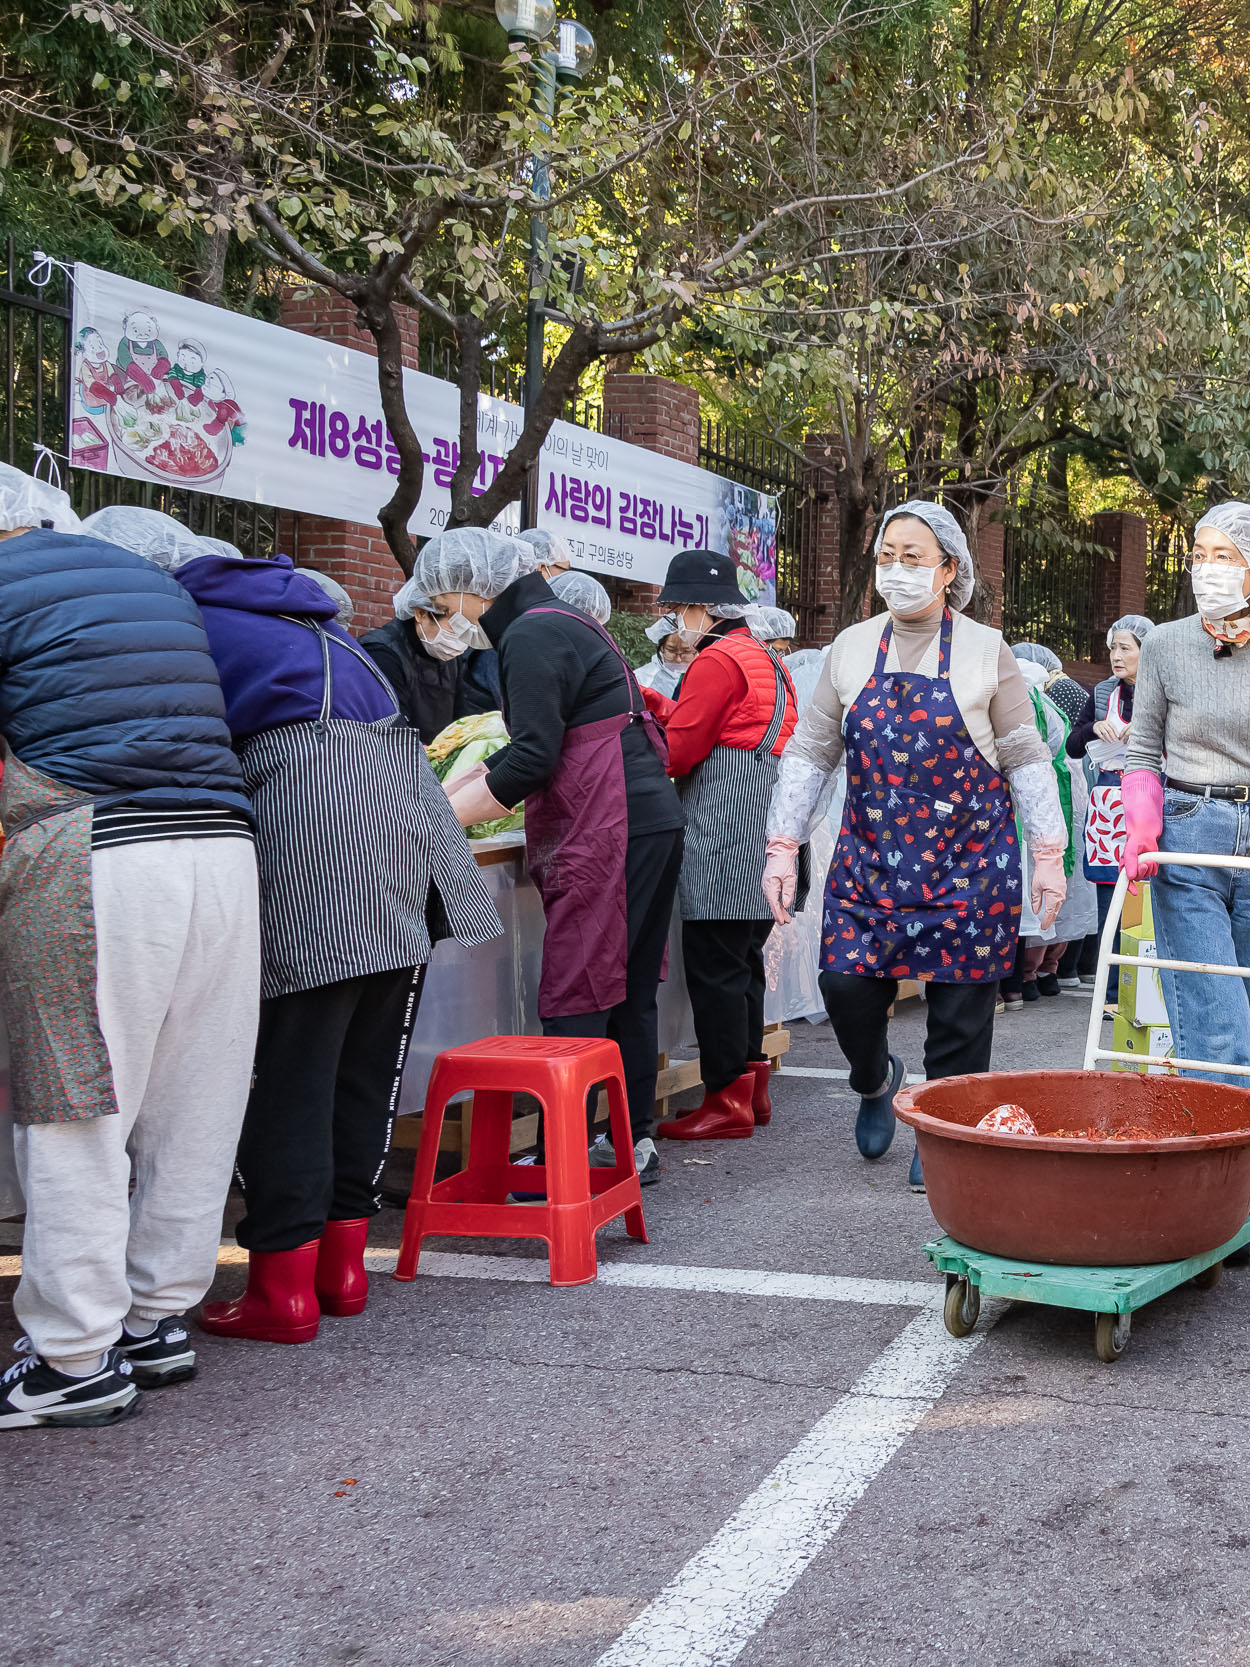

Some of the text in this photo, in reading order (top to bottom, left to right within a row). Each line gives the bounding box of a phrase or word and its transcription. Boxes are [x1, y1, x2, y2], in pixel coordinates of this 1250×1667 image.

[572, 441, 584, 466] 날
[587, 447, 609, 471] 맞이
[544, 471, 611, 529] 사랑의
[619, 492, 708, 550] 김장나누기
[589, 544, 634, 569] 구의동성당
